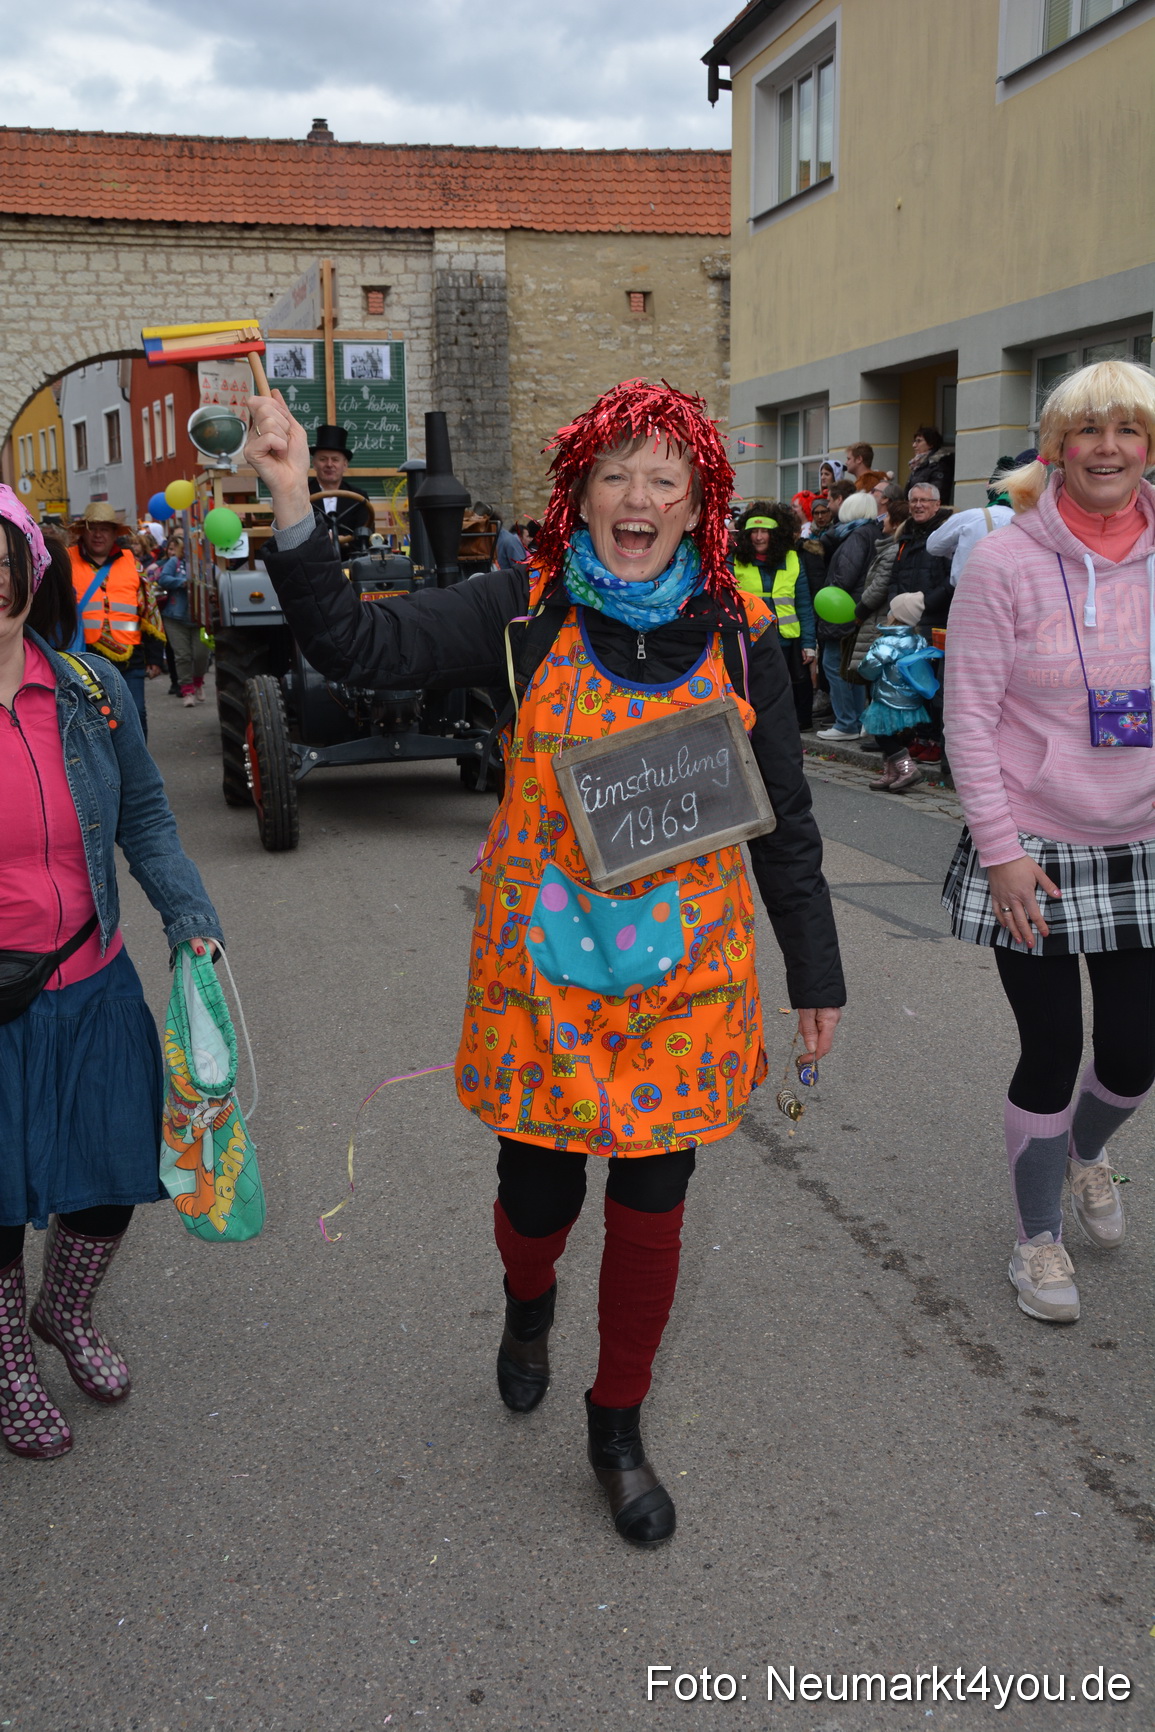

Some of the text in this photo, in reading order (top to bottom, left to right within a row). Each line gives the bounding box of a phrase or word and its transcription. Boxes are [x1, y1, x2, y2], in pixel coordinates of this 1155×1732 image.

[288, 401, 311, 414] eue
[338, 394, 401, 414] Wir haben
[364, 416, 401, 432] schon
[580, 744, 730, 813] Einschulung
[611, 791, 698, 848] 1969
